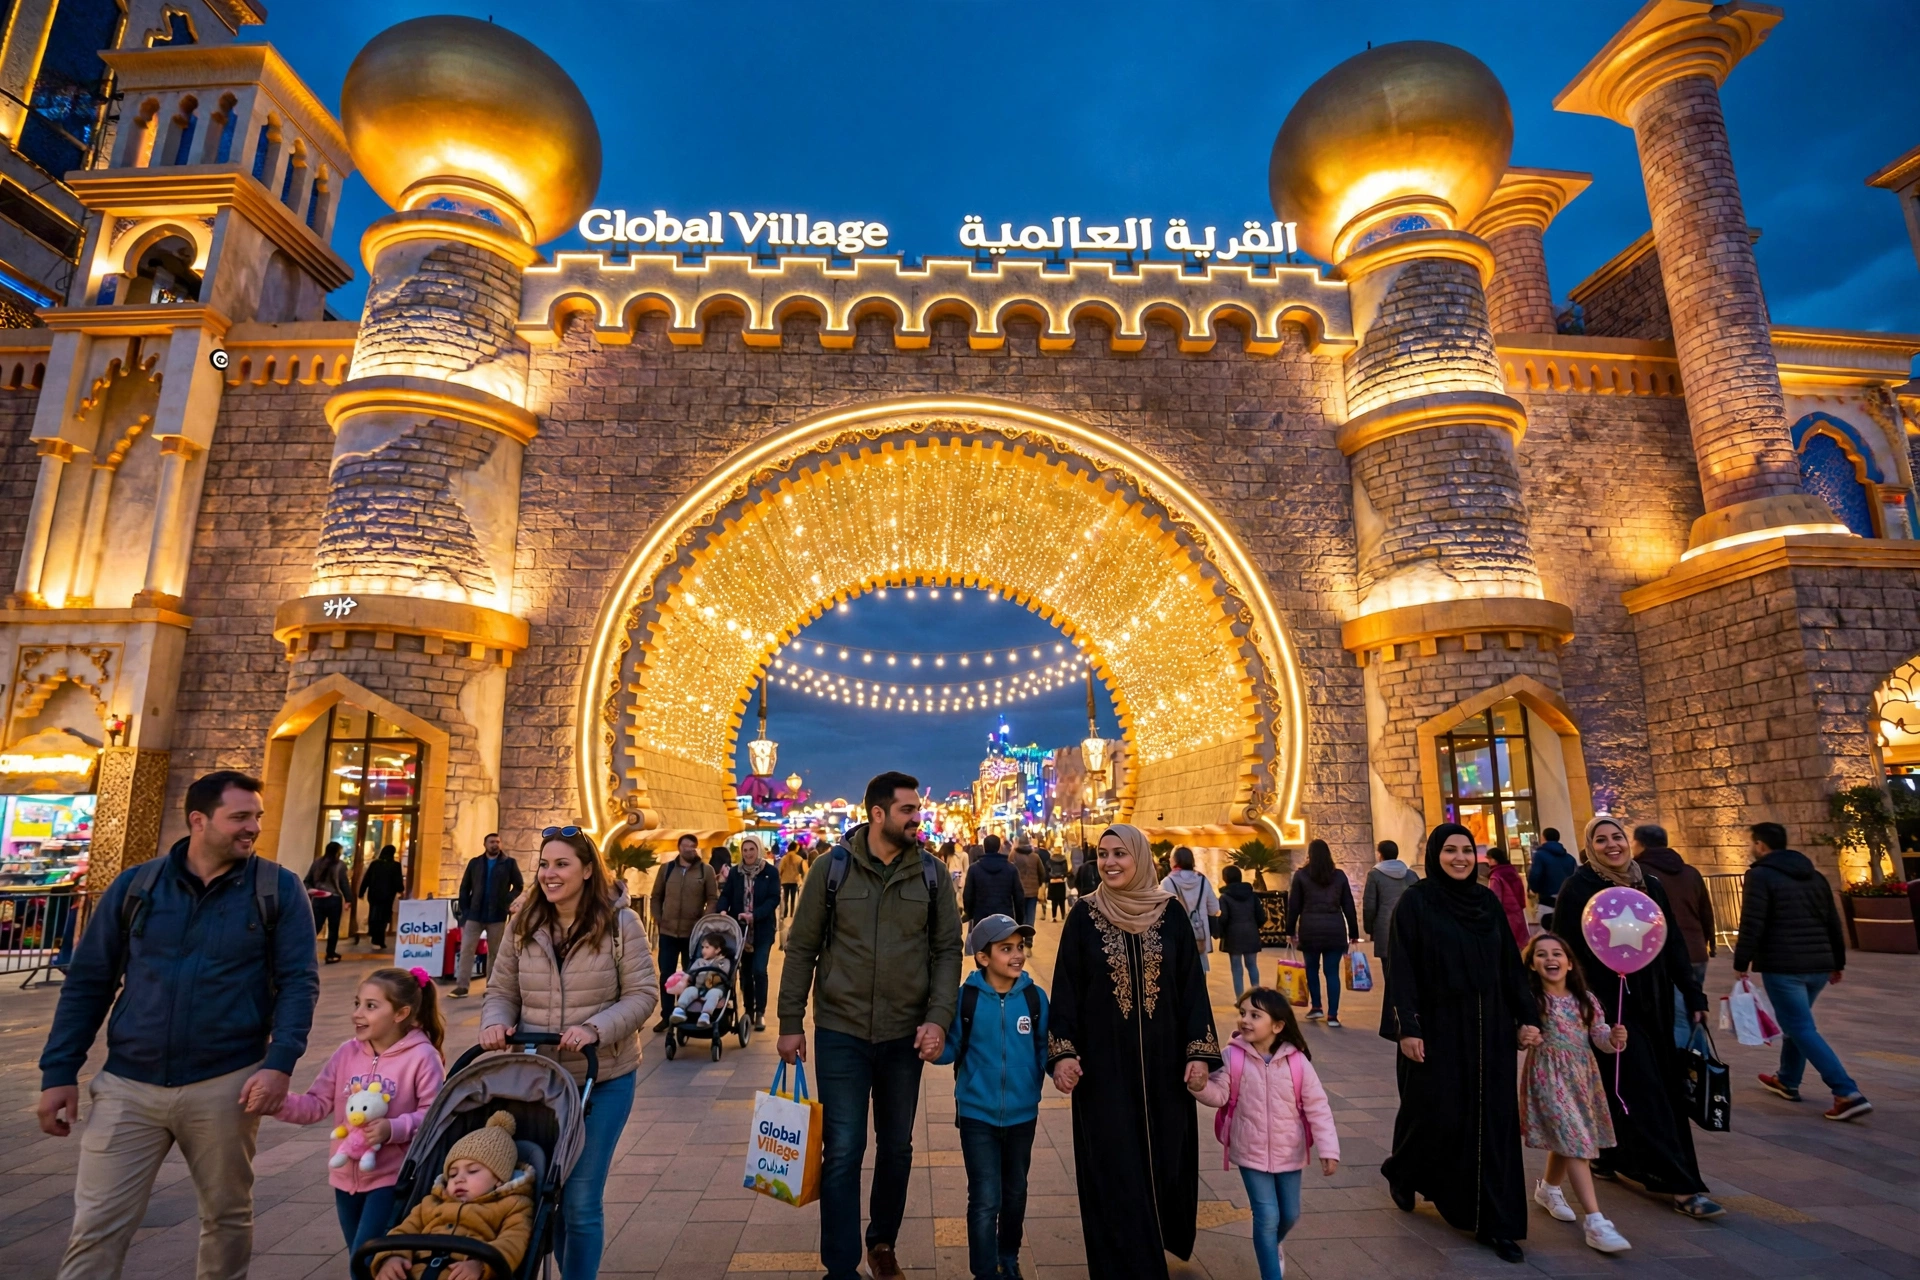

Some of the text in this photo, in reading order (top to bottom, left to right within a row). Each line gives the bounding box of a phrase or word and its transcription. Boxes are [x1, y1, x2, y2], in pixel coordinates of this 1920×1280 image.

[578, 208, 889, 253] Global Village
[959, 214, 1298, 260] القرية العالمية
[400, 921, 443, 934] Global
[759, 1120, 801, 1145] Global
[757, 1134, 799, 1162] Village
